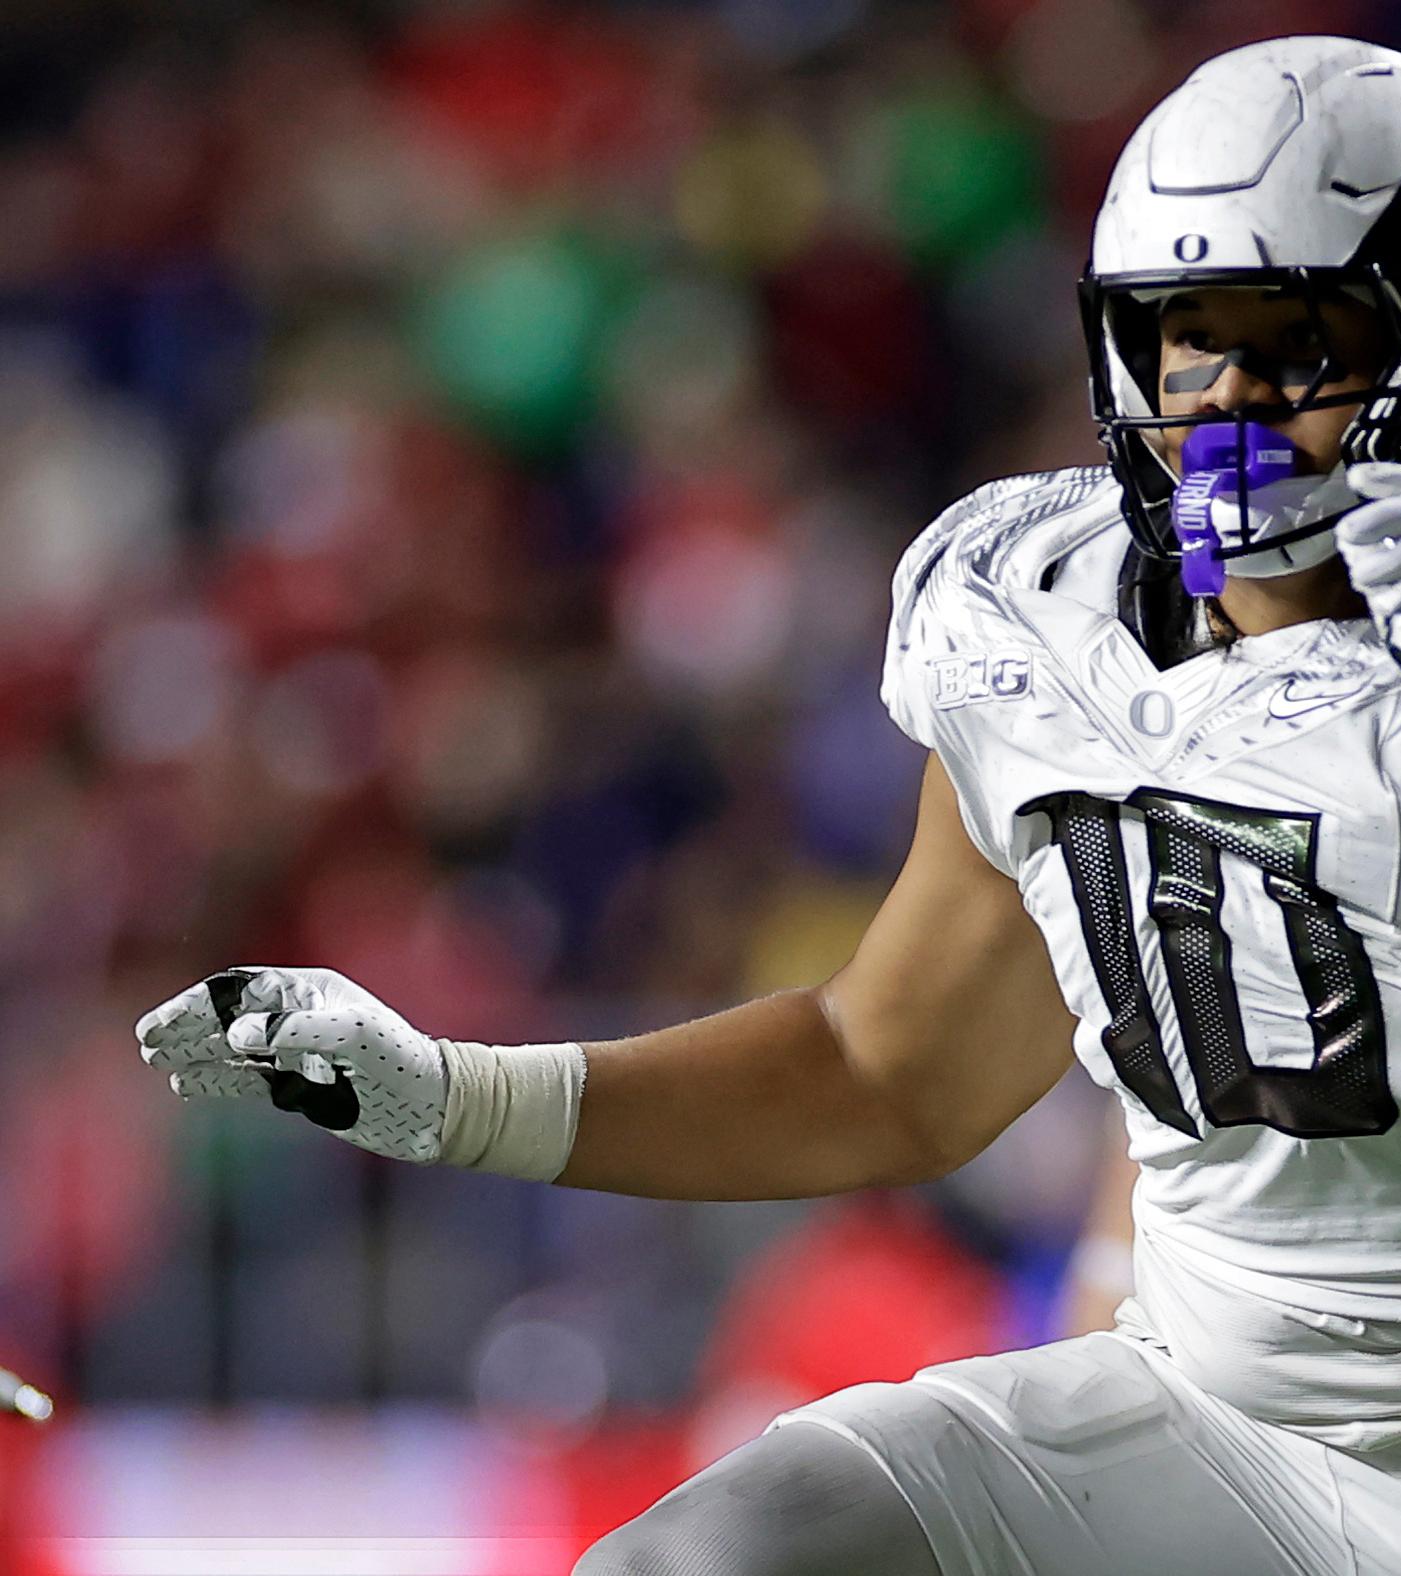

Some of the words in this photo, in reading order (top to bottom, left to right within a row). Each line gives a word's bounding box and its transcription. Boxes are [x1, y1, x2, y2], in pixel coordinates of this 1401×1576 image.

[1173, 233, 1208, 263] O
[1129, 690, 1173, 738] O
[1016, 786, 1399, 1140] 10
